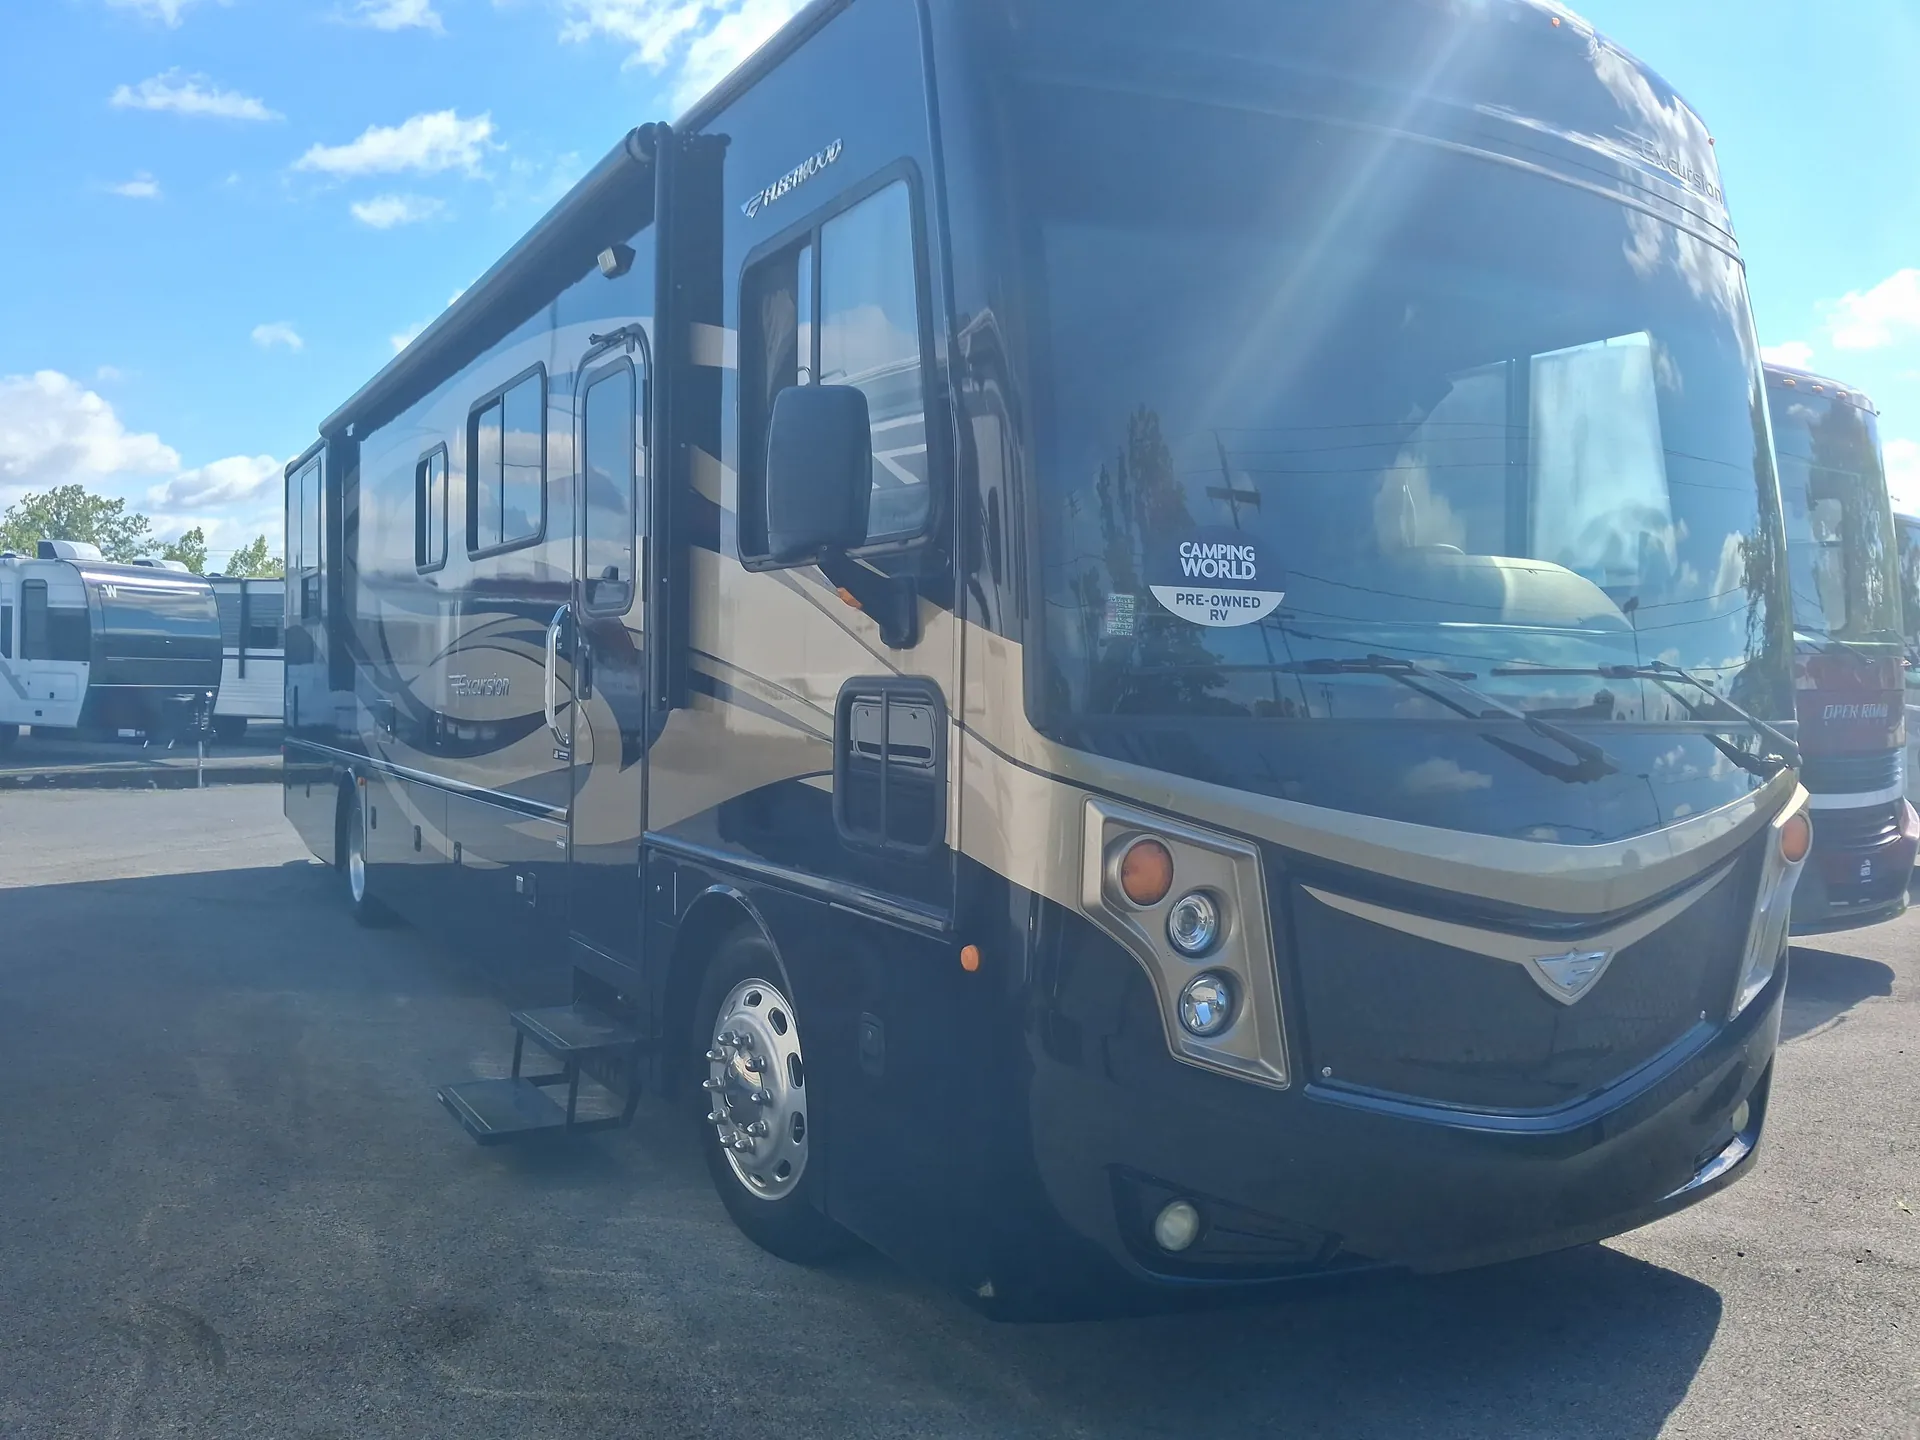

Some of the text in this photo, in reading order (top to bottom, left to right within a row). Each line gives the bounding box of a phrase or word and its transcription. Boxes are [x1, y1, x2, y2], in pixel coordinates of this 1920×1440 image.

[763, 138, 843, 206] FLEETWOOD
[1636, 139, 1723, 204] Excursion
[1179, 541, 1256, 562] CAMPING
[1180, 558, 1257, 580] WORLD
[1175, 593, 1261, 609] PRE-OWNED
[1209, 609, 1229, 621] RV
[449, 672, 510, 696] Excursion
[1822, 704, 1859, 719] OPEN
